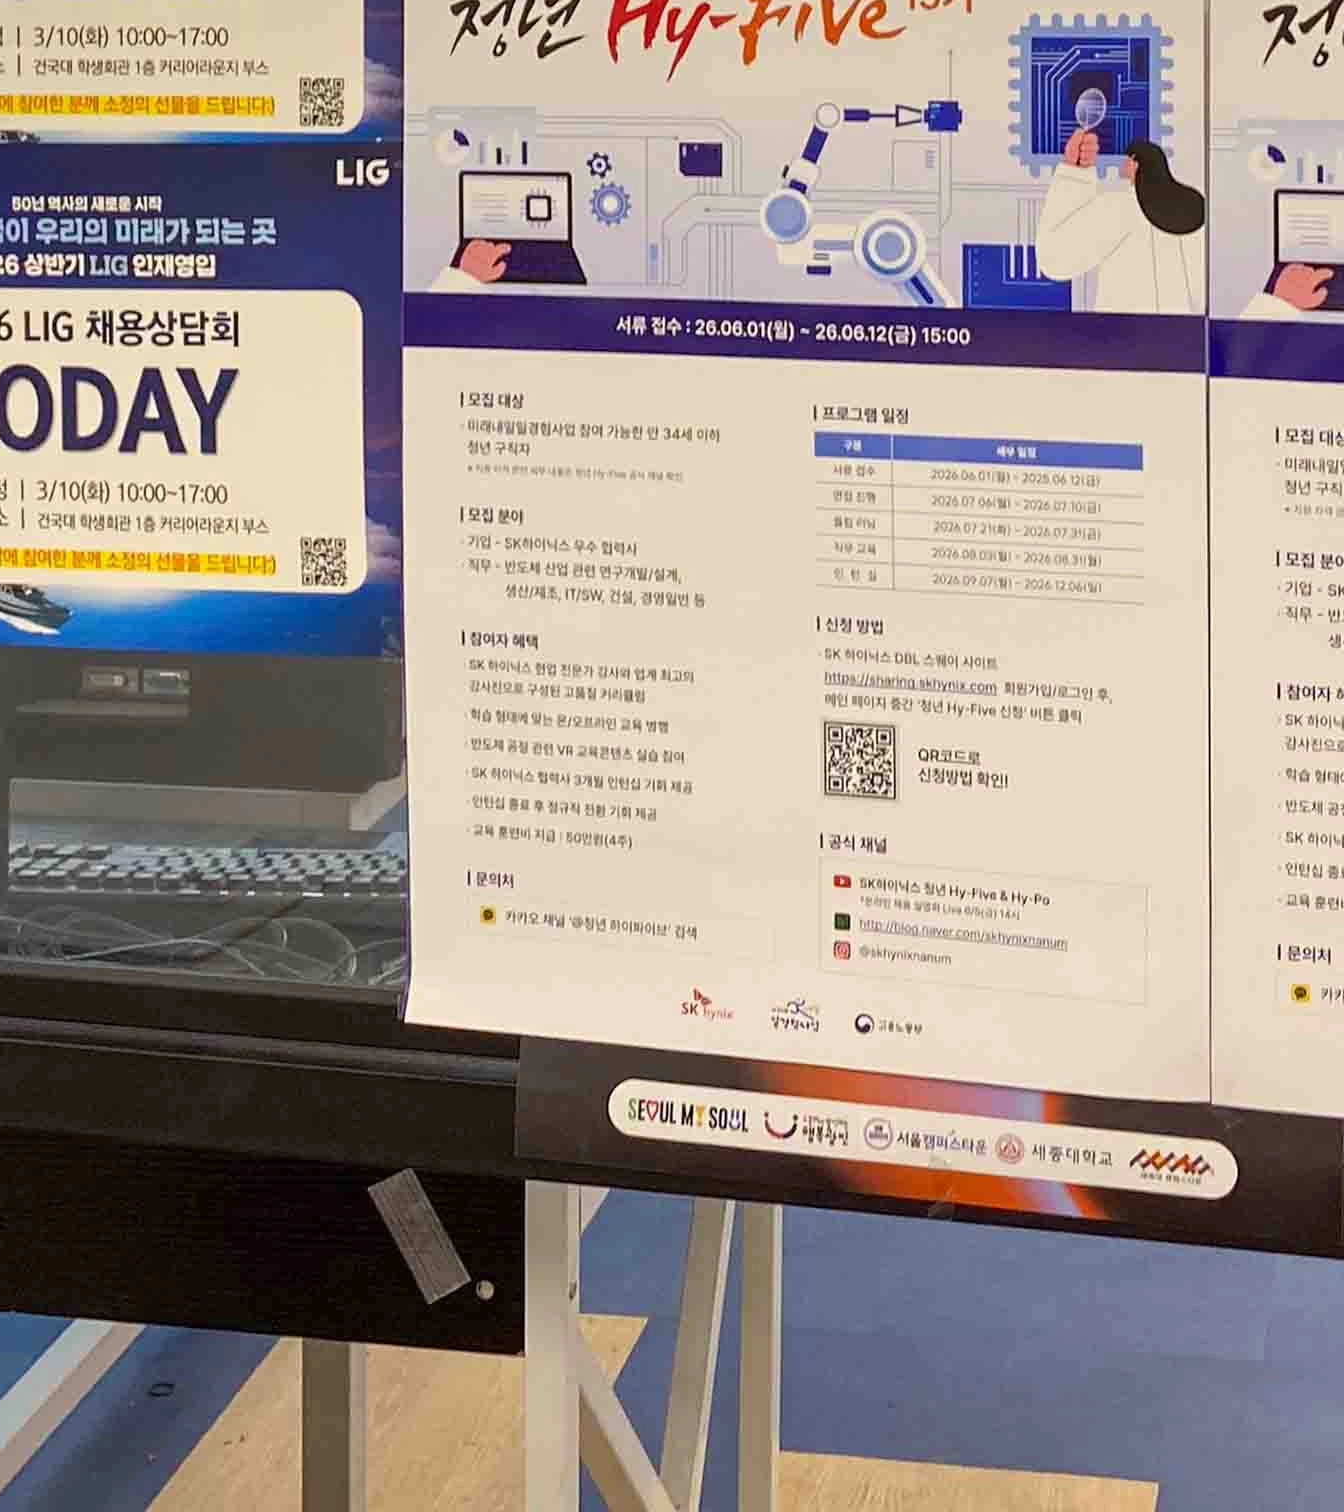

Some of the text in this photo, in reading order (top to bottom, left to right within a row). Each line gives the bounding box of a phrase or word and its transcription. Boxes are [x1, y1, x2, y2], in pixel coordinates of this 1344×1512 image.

[35, 25, 108, 48] 3/10(화)
[117, 27, 228, 46] 10:00~17:00
[34, 59, 72, 75] 건국대
[78, 59, 130, 76] 학생회관
[136, 59, 155, 76] 1층
[160, 59, 238, 76] 커리어라운지
[243, 60, 269, 76] 부스
[337, 159, 389, 186] LIG
[24, 311, 73, 342] LIG
[86, 310, 239, 347] 채용상담회
[1286, 429, 1314, 445] 모집
[37, 480, 110, 504] 3/10(화)
[118, 483, 228, 504] 10:00~17:00
[1286, 552, 1314, 568] 모집
